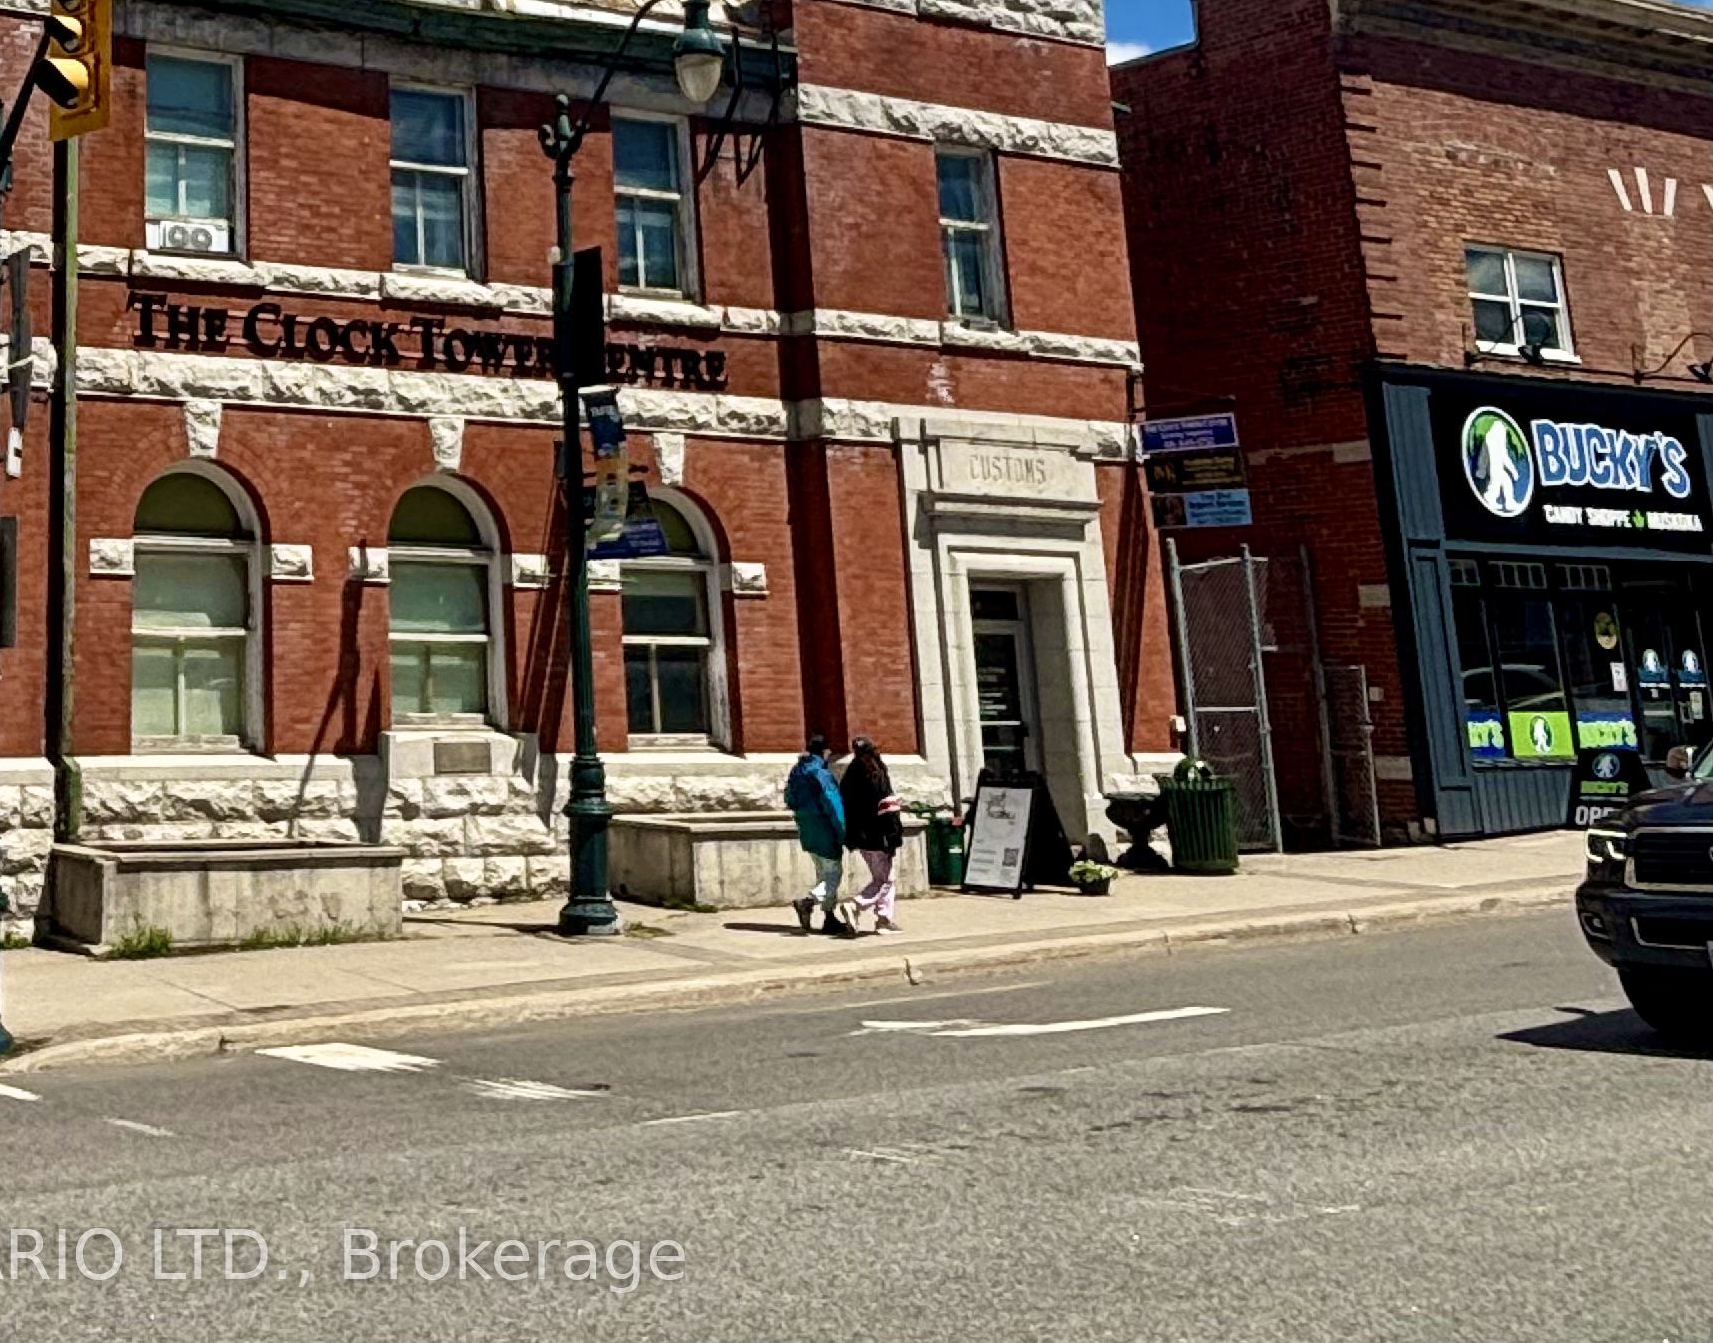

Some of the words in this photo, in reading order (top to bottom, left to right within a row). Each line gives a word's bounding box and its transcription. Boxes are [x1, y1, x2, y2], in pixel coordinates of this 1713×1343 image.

[607, 344, 728, 391] ENTRE
[969, 454, 1047, 485] CUSTOMS
[1530, 419, 1691, 498] BUCKY'S
